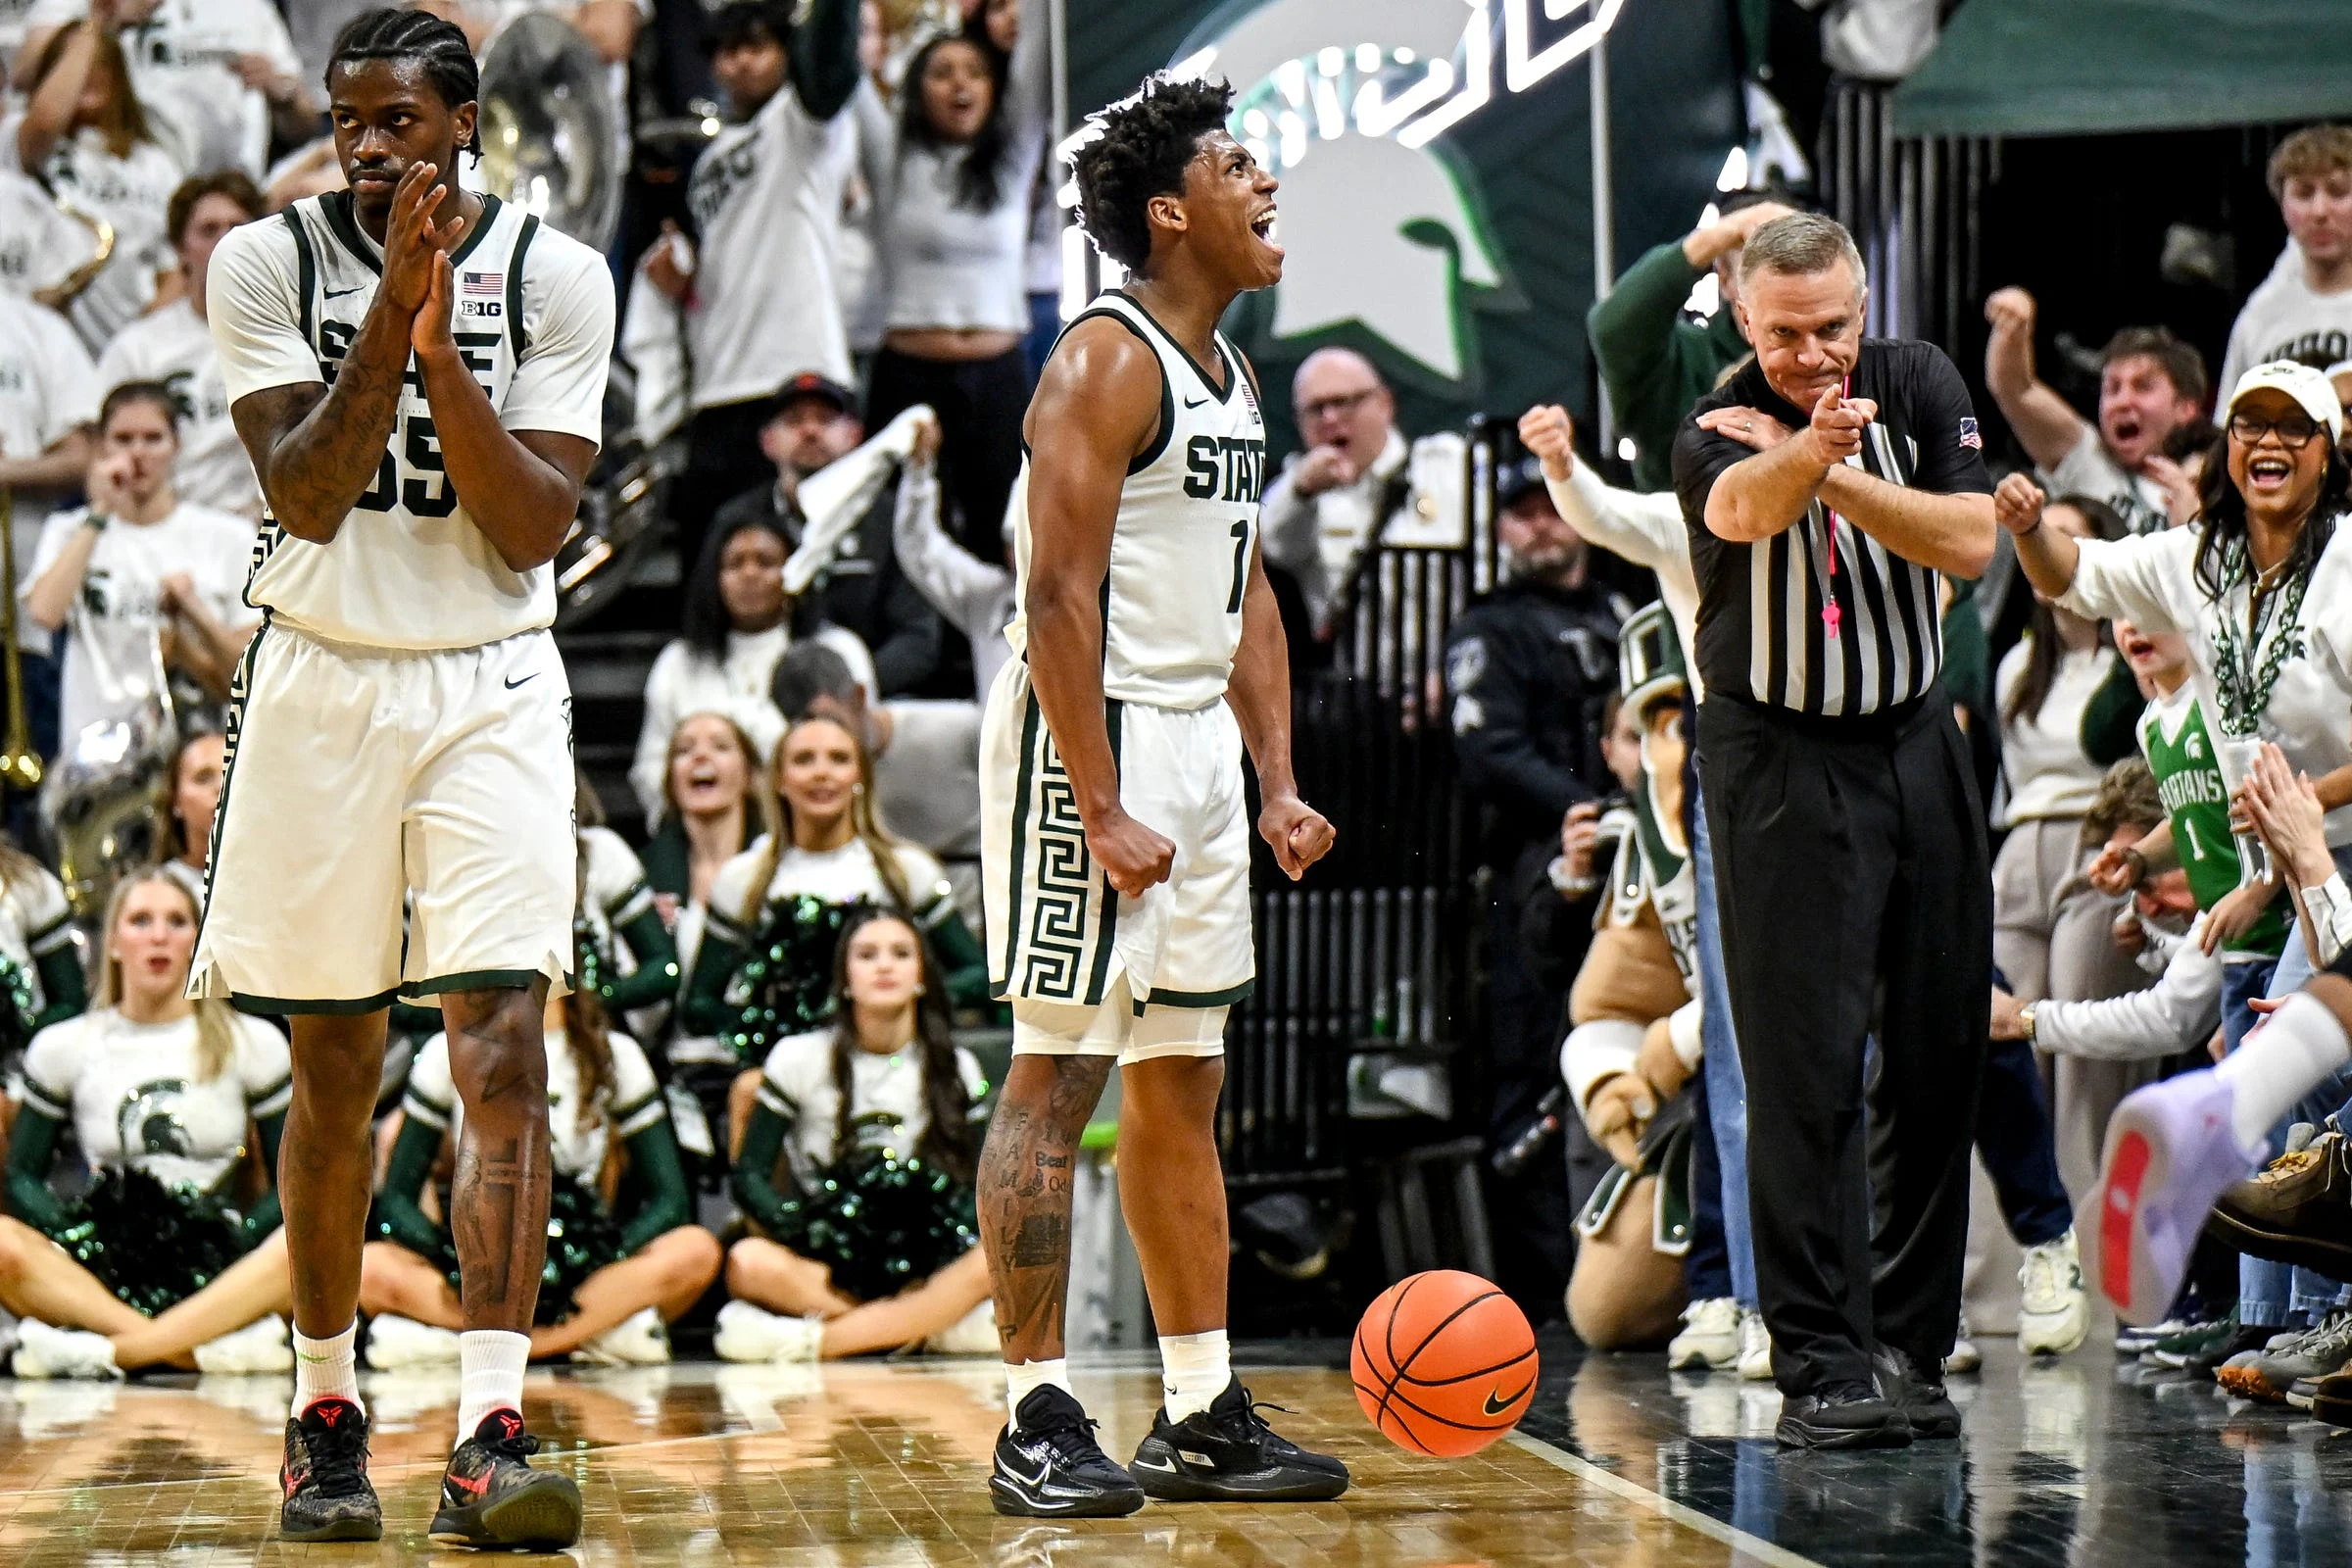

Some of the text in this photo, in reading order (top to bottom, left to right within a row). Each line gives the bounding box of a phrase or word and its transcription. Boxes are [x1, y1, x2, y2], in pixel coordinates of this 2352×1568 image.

[462, 300, 502, 317] B1G
[1183, 435, 1265, 503] STAT
[1226, 519, 1249, 613] 1
[2158, 768, 2223, 820] PARTANS
[2184, 817, 2205, 860] 1
